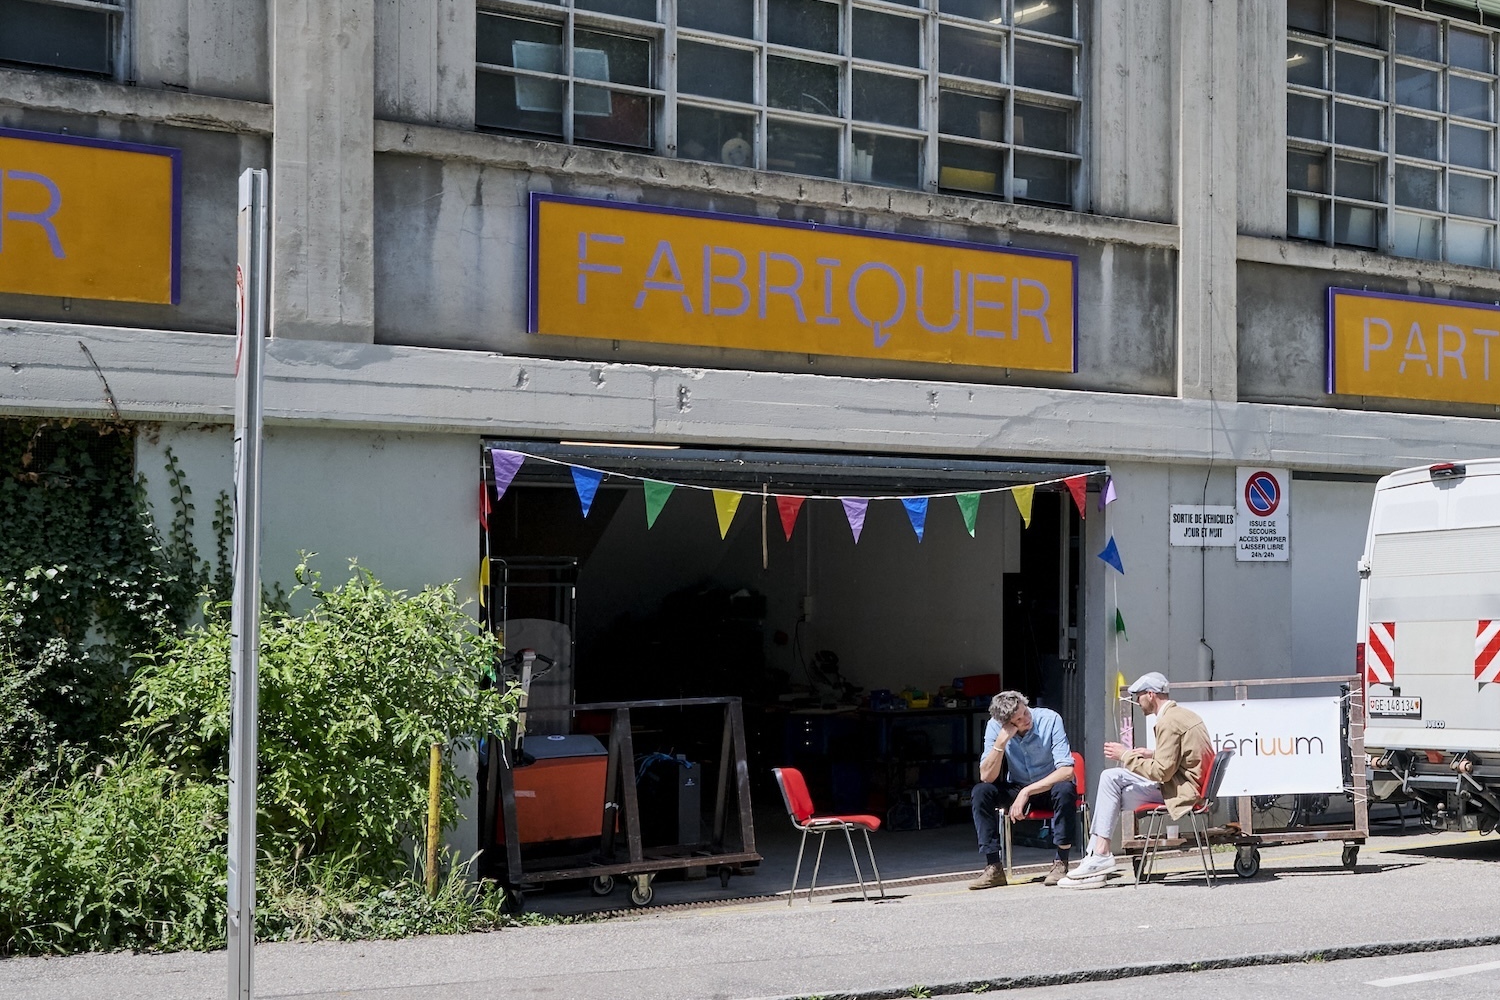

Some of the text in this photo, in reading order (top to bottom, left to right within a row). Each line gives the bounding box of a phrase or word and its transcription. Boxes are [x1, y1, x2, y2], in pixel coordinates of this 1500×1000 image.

[577, 231, 1053, 347] FABRIQUER
[1173, 513, 1234, 525] SORTIE DE VEHICULES
[1184, 527, 1223, 538] JOUR ET NUIT
[1241, 543, 1284, 551] LAISSER LIBRE
[1425, 720, 1446, 729] IVECO
